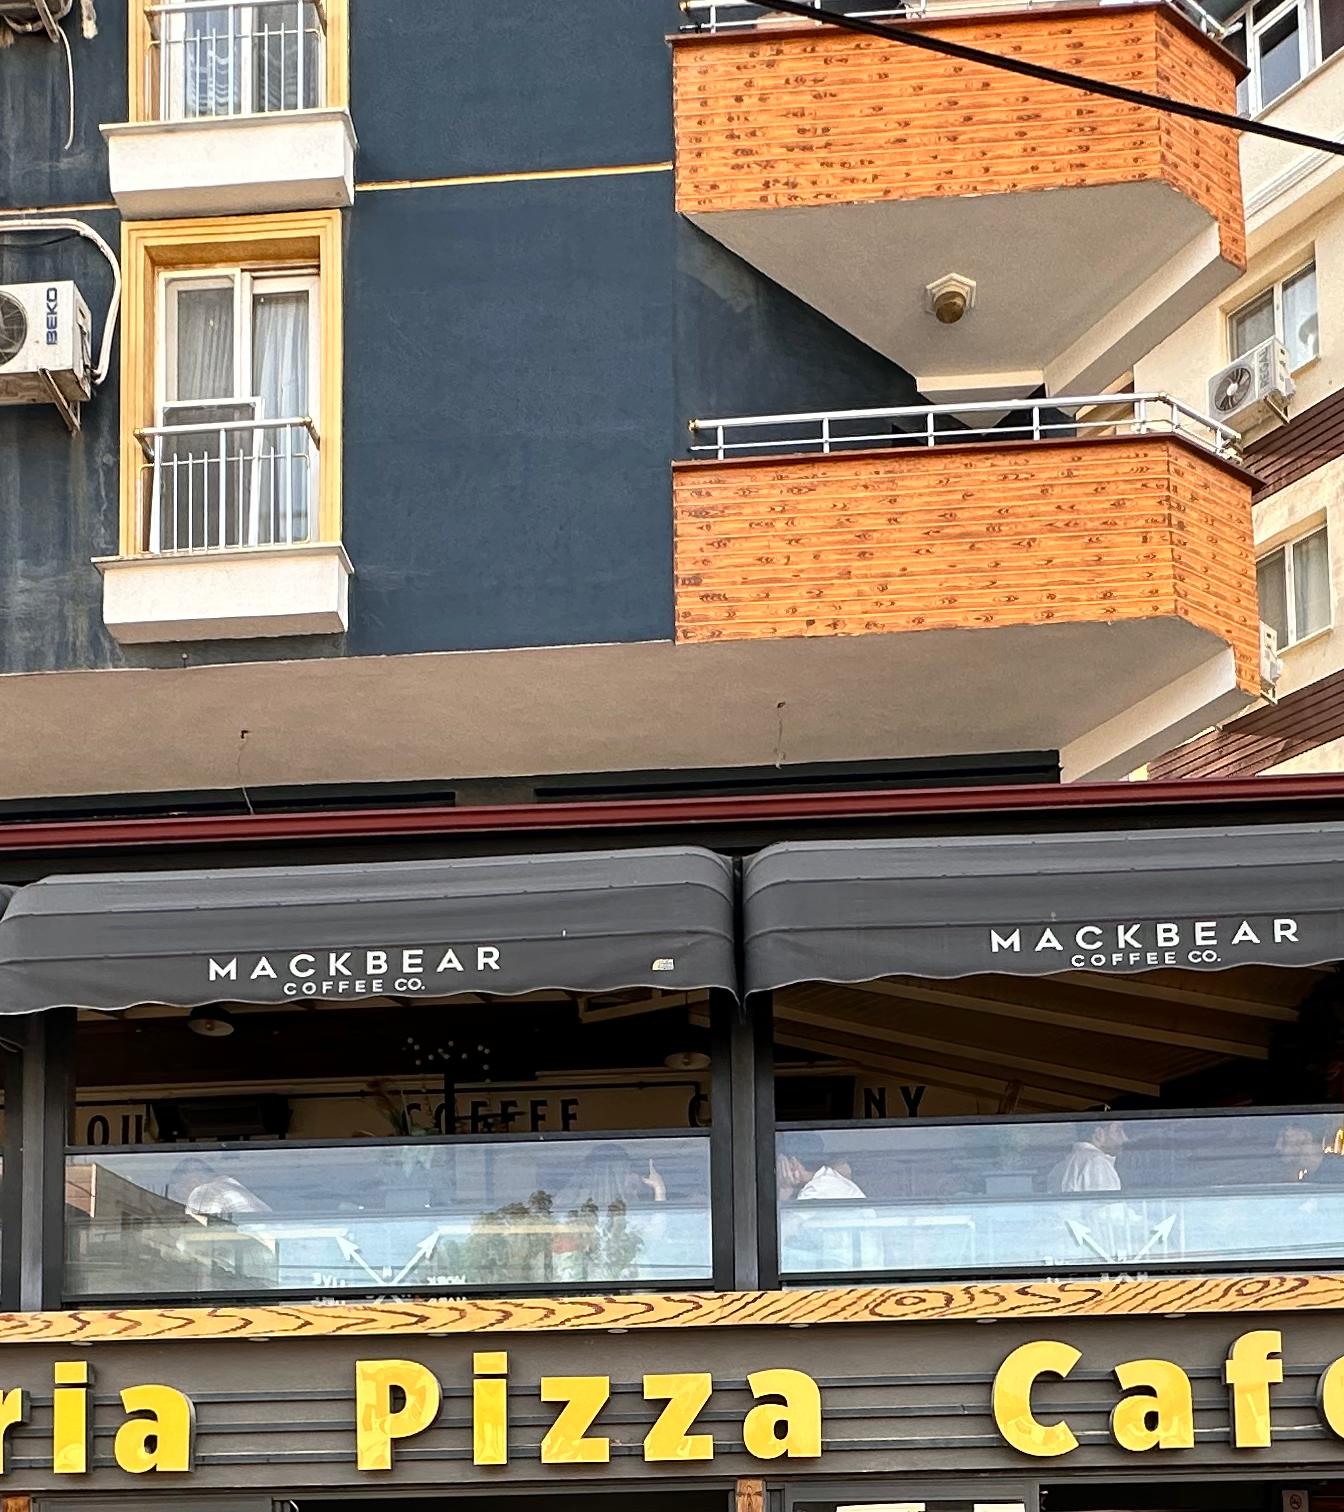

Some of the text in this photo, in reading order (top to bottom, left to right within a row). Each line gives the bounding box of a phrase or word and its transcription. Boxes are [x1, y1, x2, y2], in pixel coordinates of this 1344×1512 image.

[46, 287, 58, 346] BEKO
[990, 918, 1299, 952] MACKBEAR
[208, 946, 501, 981] MACKBEAR
[1071, 951, 1177, 967] COFFEE
[283, 979, 384, 995] COFFEE
[356, 1351, 823, 1470] Pizza
